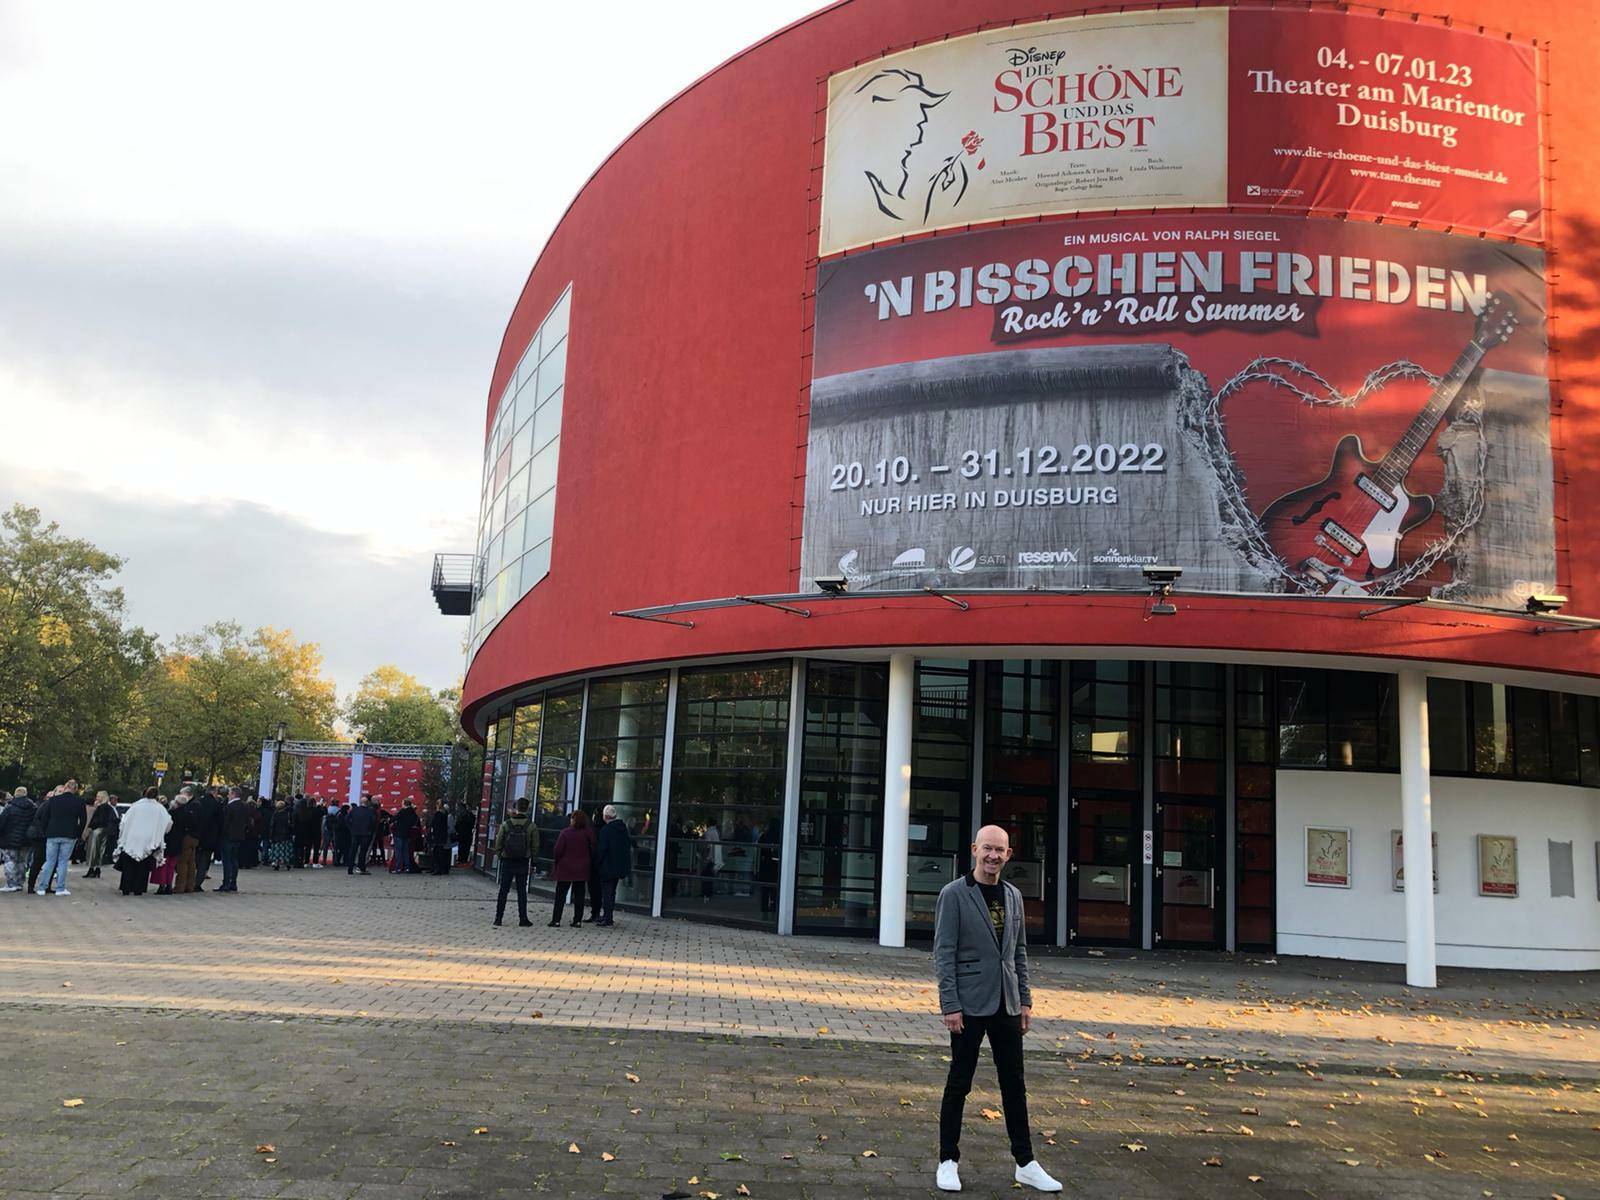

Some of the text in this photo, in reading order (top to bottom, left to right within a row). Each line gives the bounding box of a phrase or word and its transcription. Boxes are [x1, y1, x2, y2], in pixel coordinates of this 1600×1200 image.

[1005, 47, 1066, 67] Disney
[1026, 63, 1053, 78] DIE
[1317, 46, 1354, 70] 04.
[1375, 52, 1473, 87] 07.01.23
[993, 64, 1184, 113] SCHÖNE
[1247, 69, 1525, 127] Theater am Marientor
[1063, 103, 1134, 120] UND DAS
[1337, 103, 1458, 148] Duisburg
[1019, 111, 1156, 157] BIEST
[1273, 146, 1508, 185] www.die-schoene-und-das-biest-musical.de
[1350, 168, 1442, 188] www.tam.theater
[1063, 230, 1281, 246] EIN MUSICAL VON RALPH SIEGEL
[923, 251, 1223, 313] BISSCHEN
[1239, 251, 1488, 317] FRIEDEN
[1184, 294, 1305, 324] Summer
[830, 455, 919, 491] 20.10.
[960, 443, 1166, 480] 31.12.2022
[861, 487, 1118, 516] NUR HIER IN DUISBURG
[1018, 548, 1080, 568] reservix
